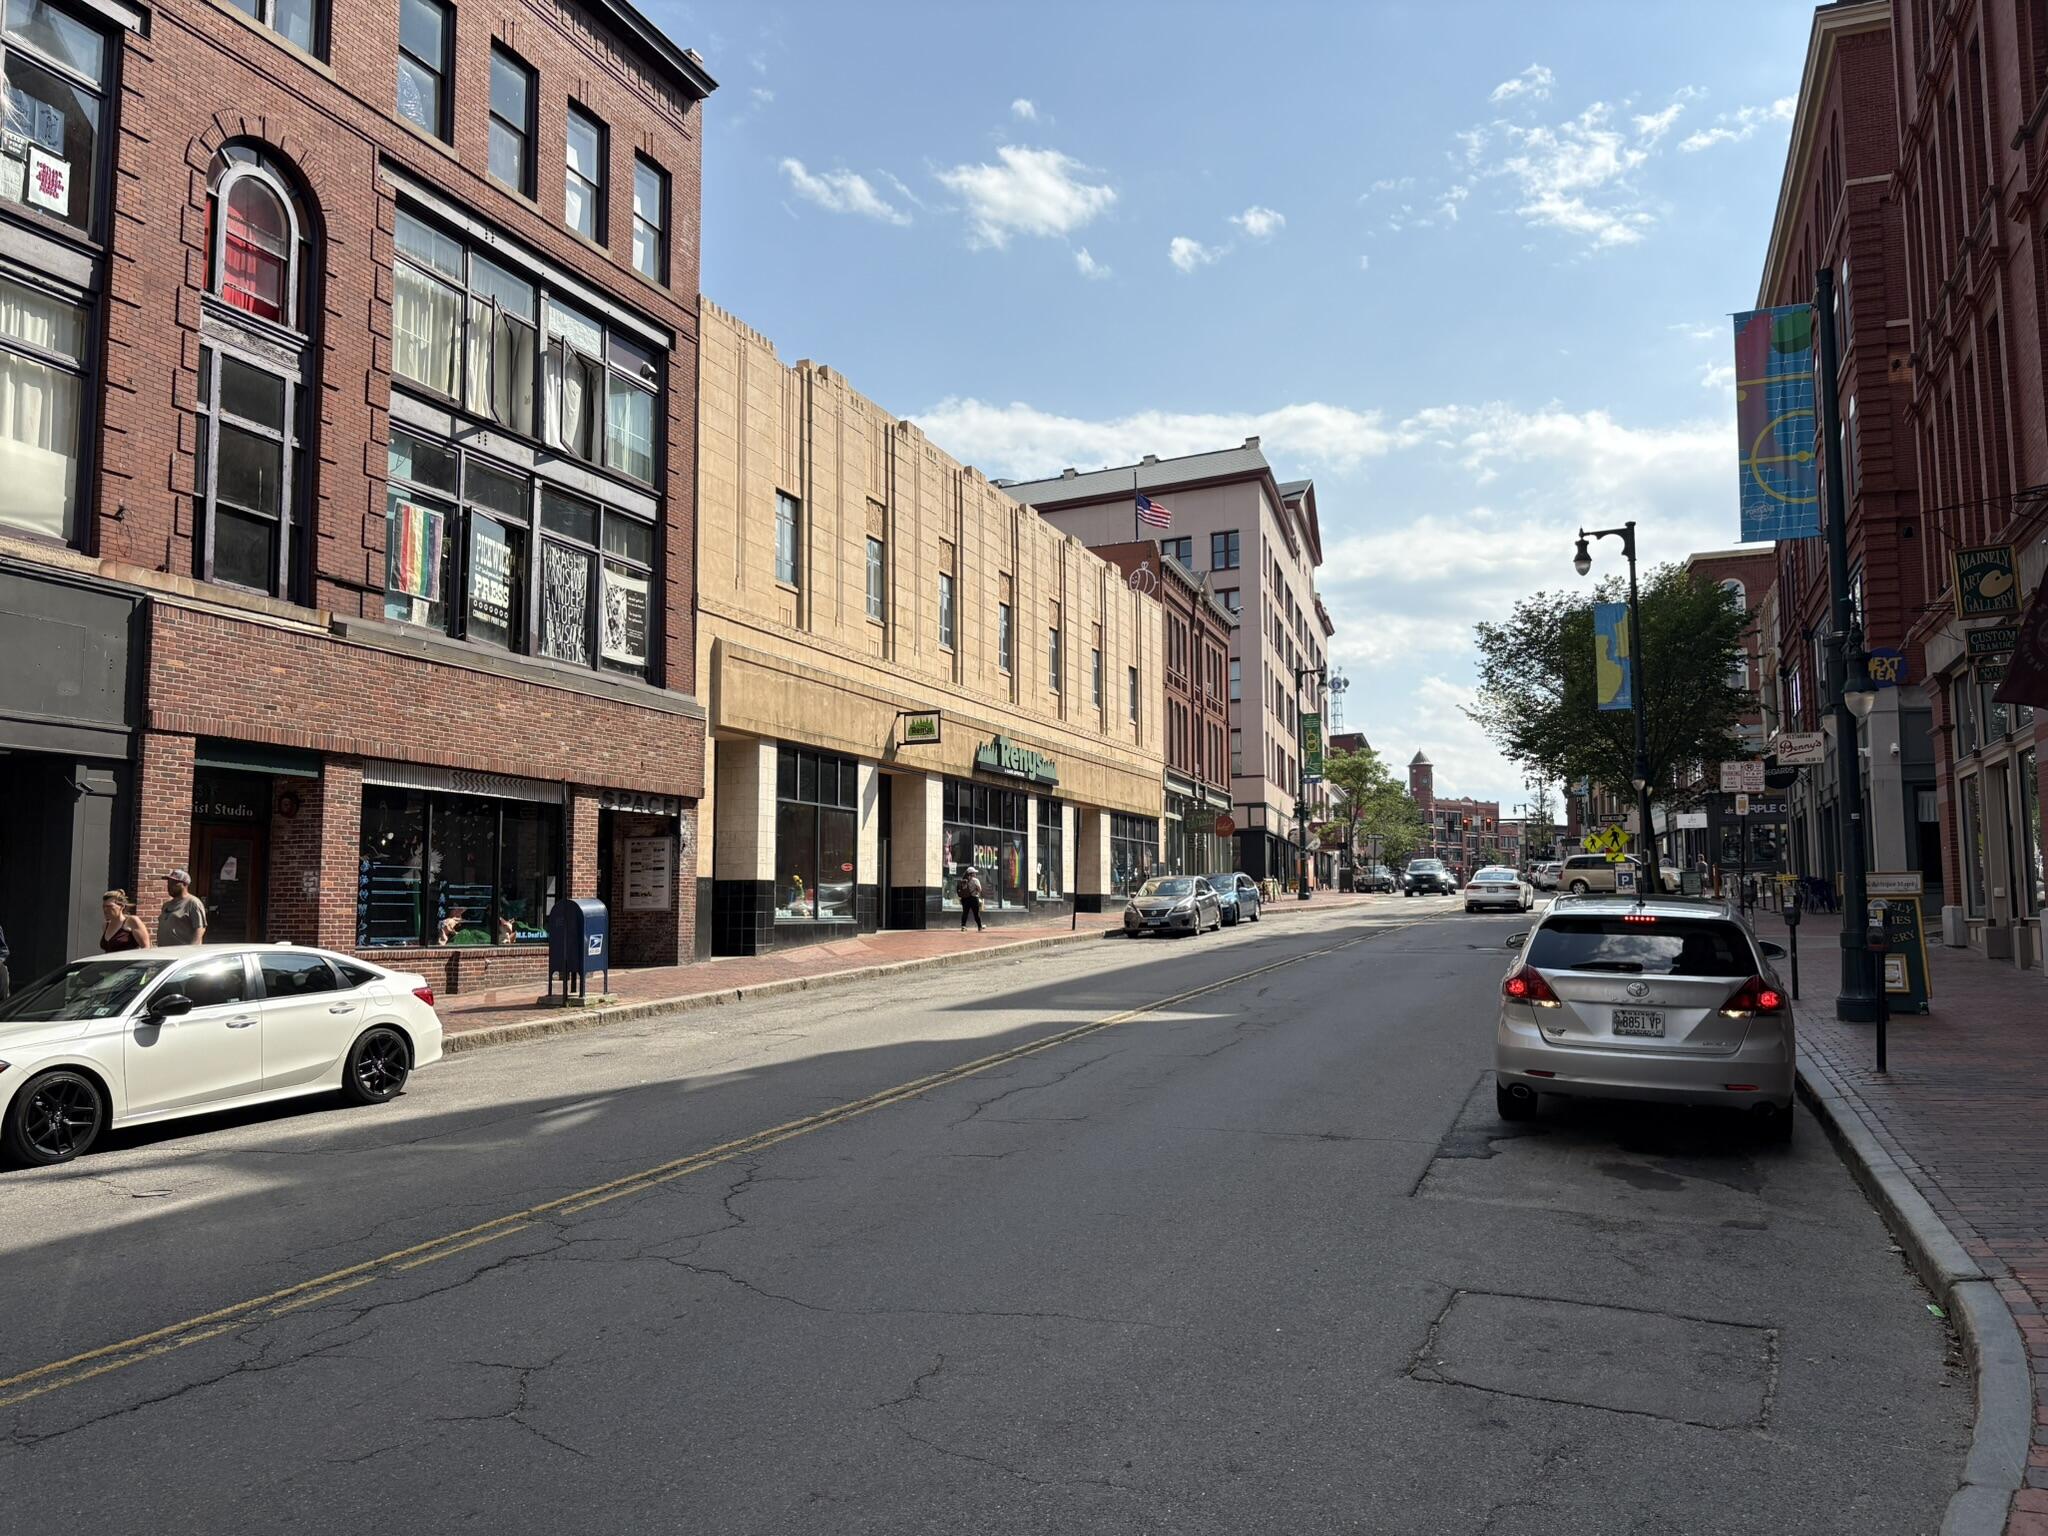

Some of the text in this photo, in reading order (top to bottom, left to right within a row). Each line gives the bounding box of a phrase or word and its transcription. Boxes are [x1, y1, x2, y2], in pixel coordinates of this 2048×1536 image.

[475, 532, 511, 576] PICKWICK
[1958, 548, 2010, 573] MAINELY
[473, 573, 509, 609] PRESS
[1963, 572, 1982, 593] ART
[1963, 588, 2015, 613] GALLERY
[1970, 630, 2016, 645] CUSTOM
[1975, 640, 2015, 652] FRAMING
[1868, 657, 1903, 672] NEXT
[1870, 669, 1896, 682] TEA
[1000, 735, 1044, 780] Renys
[215, 803, 253, 816] Studio
[601, 790, 674, 814] SPACE
[973, 844, 998, 870] PRIDE
[1622, 1016, 1661, 1029] 8851 VP
